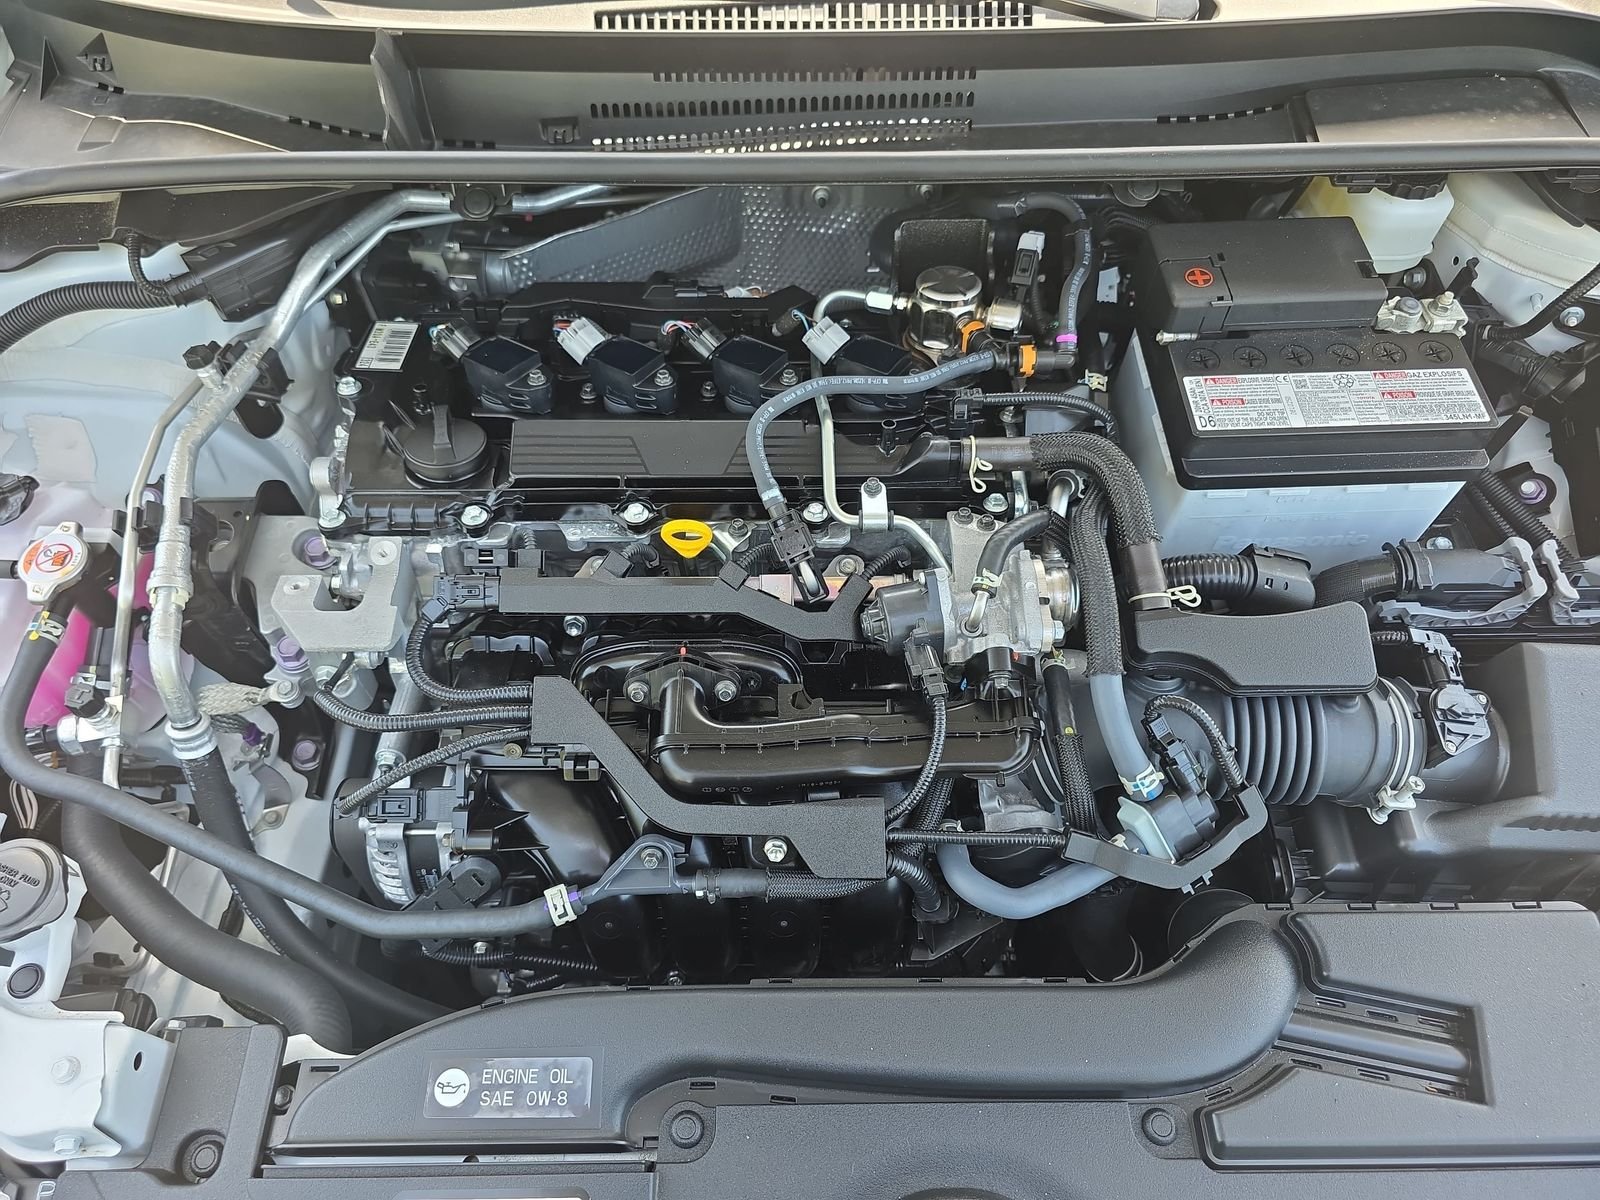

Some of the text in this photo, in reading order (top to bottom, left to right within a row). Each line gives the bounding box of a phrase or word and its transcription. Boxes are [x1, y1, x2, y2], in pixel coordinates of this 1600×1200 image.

[1198, 415, 1217, 428] D6
[1214, 531, 1369, 552] Panasonic
[19, 873, 41, 887] FLUID
[481, 1068, 574, 1084] ENGINE OIL
[479, 1090, 568, 1107] SAE 0W-8
